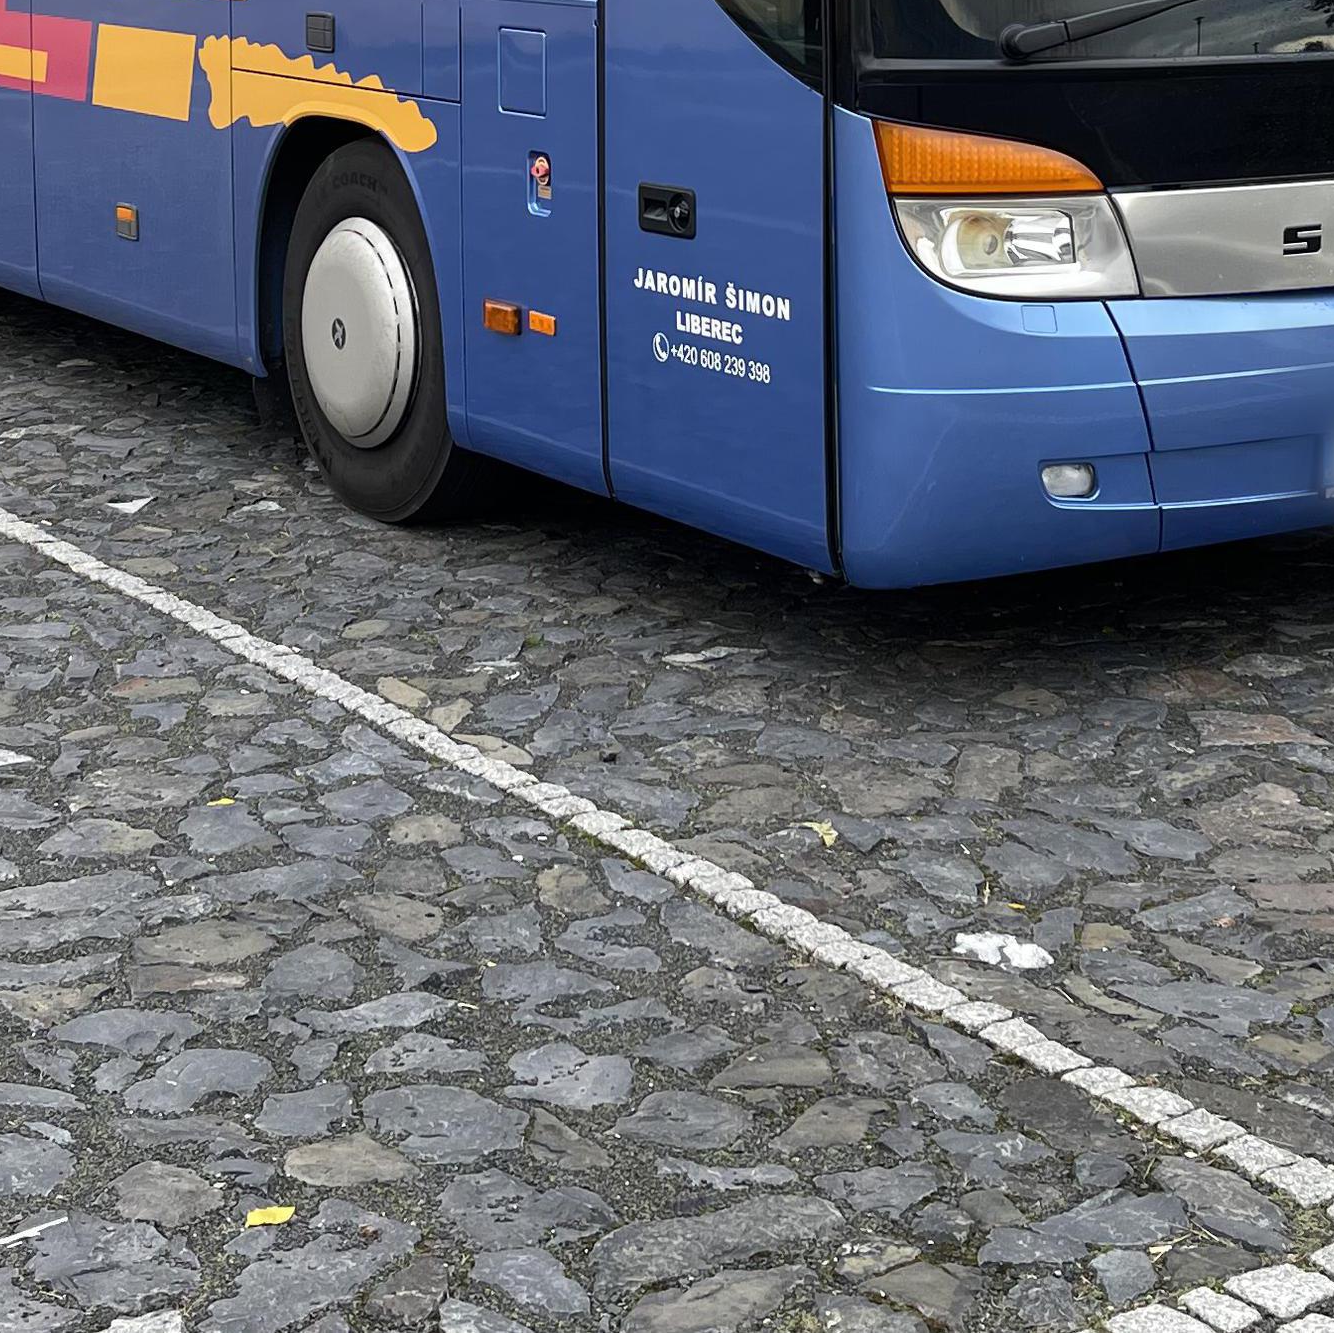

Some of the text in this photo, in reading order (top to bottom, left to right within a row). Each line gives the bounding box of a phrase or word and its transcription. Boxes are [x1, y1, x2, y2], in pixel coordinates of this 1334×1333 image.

[633, 267, 791, 321] JAROMÍR ŠIMON
[676, 311, 743, 345] LIBEREC
[670, 342, 771, 384] +420 608 239 398
